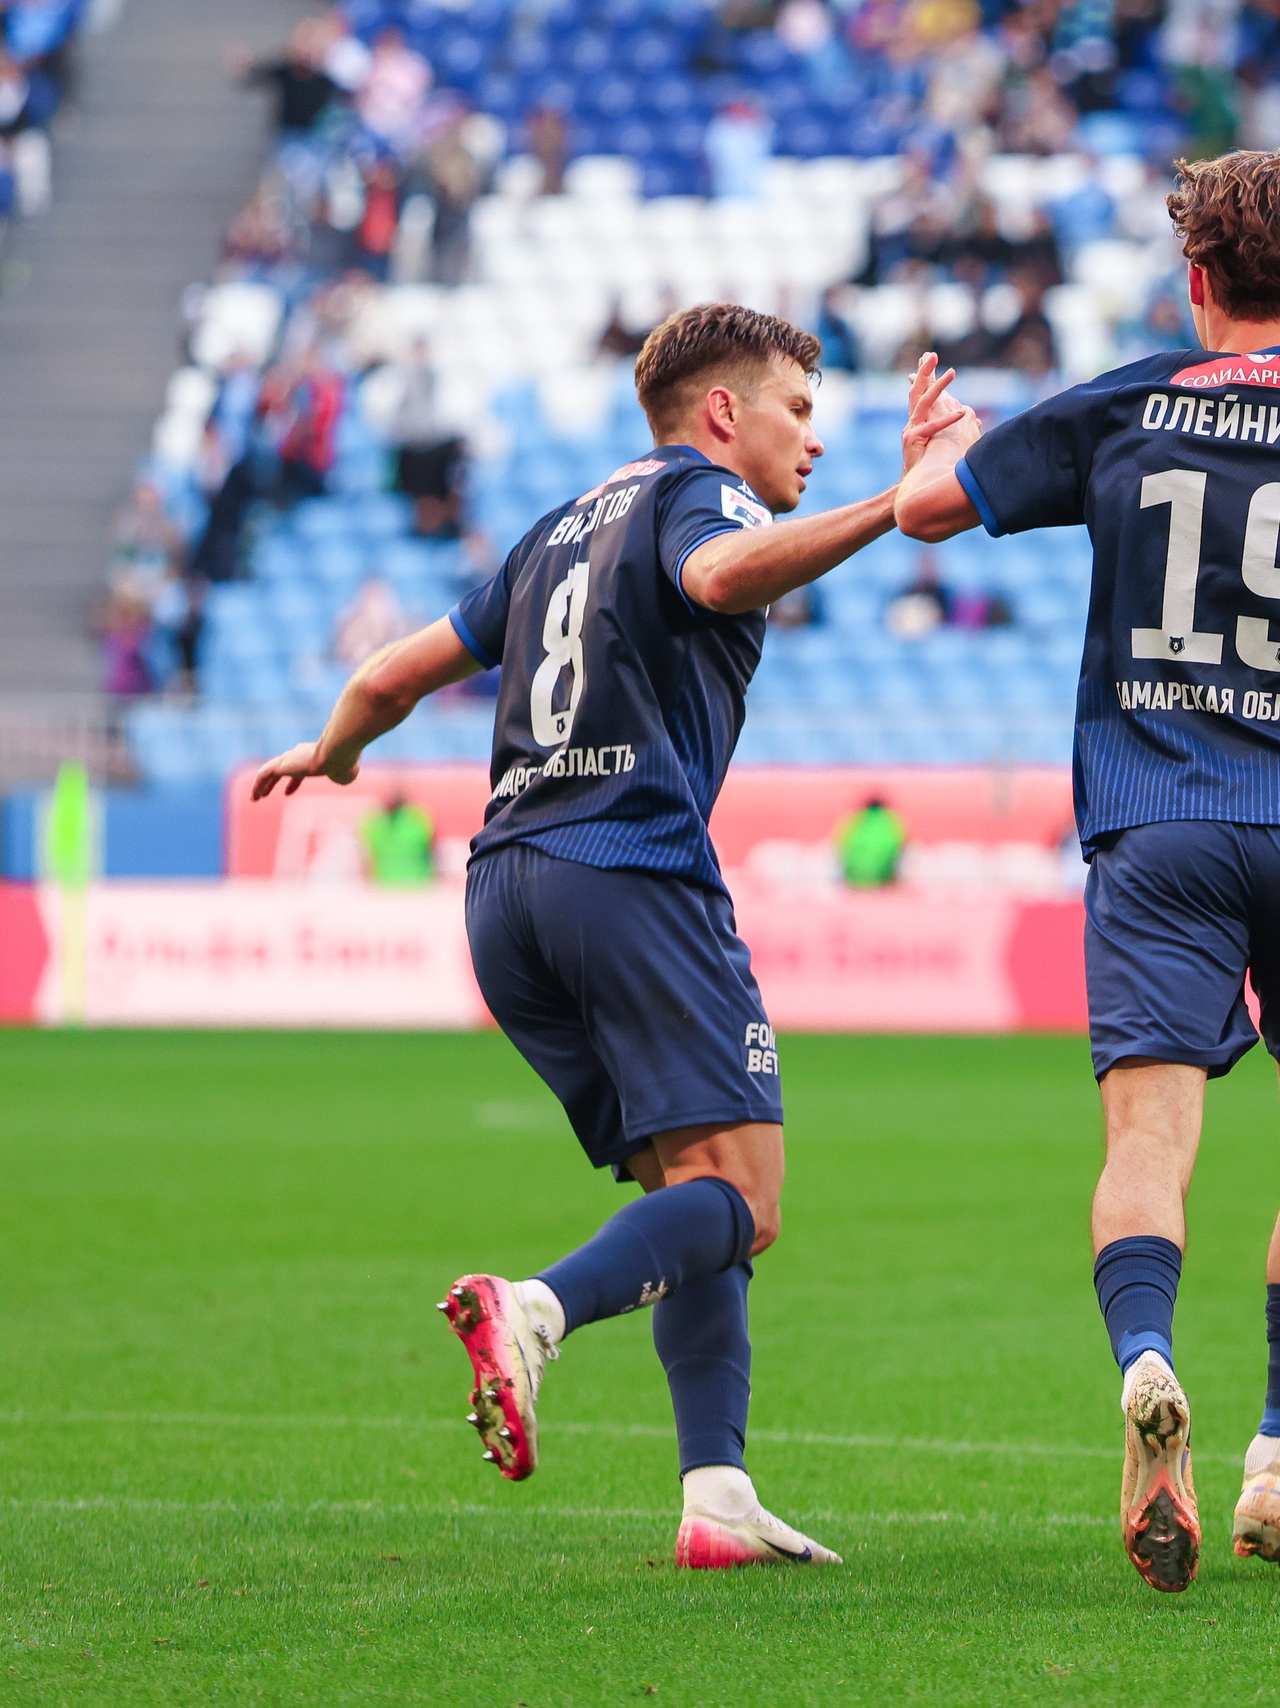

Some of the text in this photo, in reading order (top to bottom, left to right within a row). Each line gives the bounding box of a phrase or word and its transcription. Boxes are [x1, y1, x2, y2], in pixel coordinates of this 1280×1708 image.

[530, 561, 591, 748] 8
[1116, 681, 1235, 715] АМАРСКАЯ
[542, 743, 637, 778] ОБЛАСТЬ
[747, 1048, 779, 1076] BET
